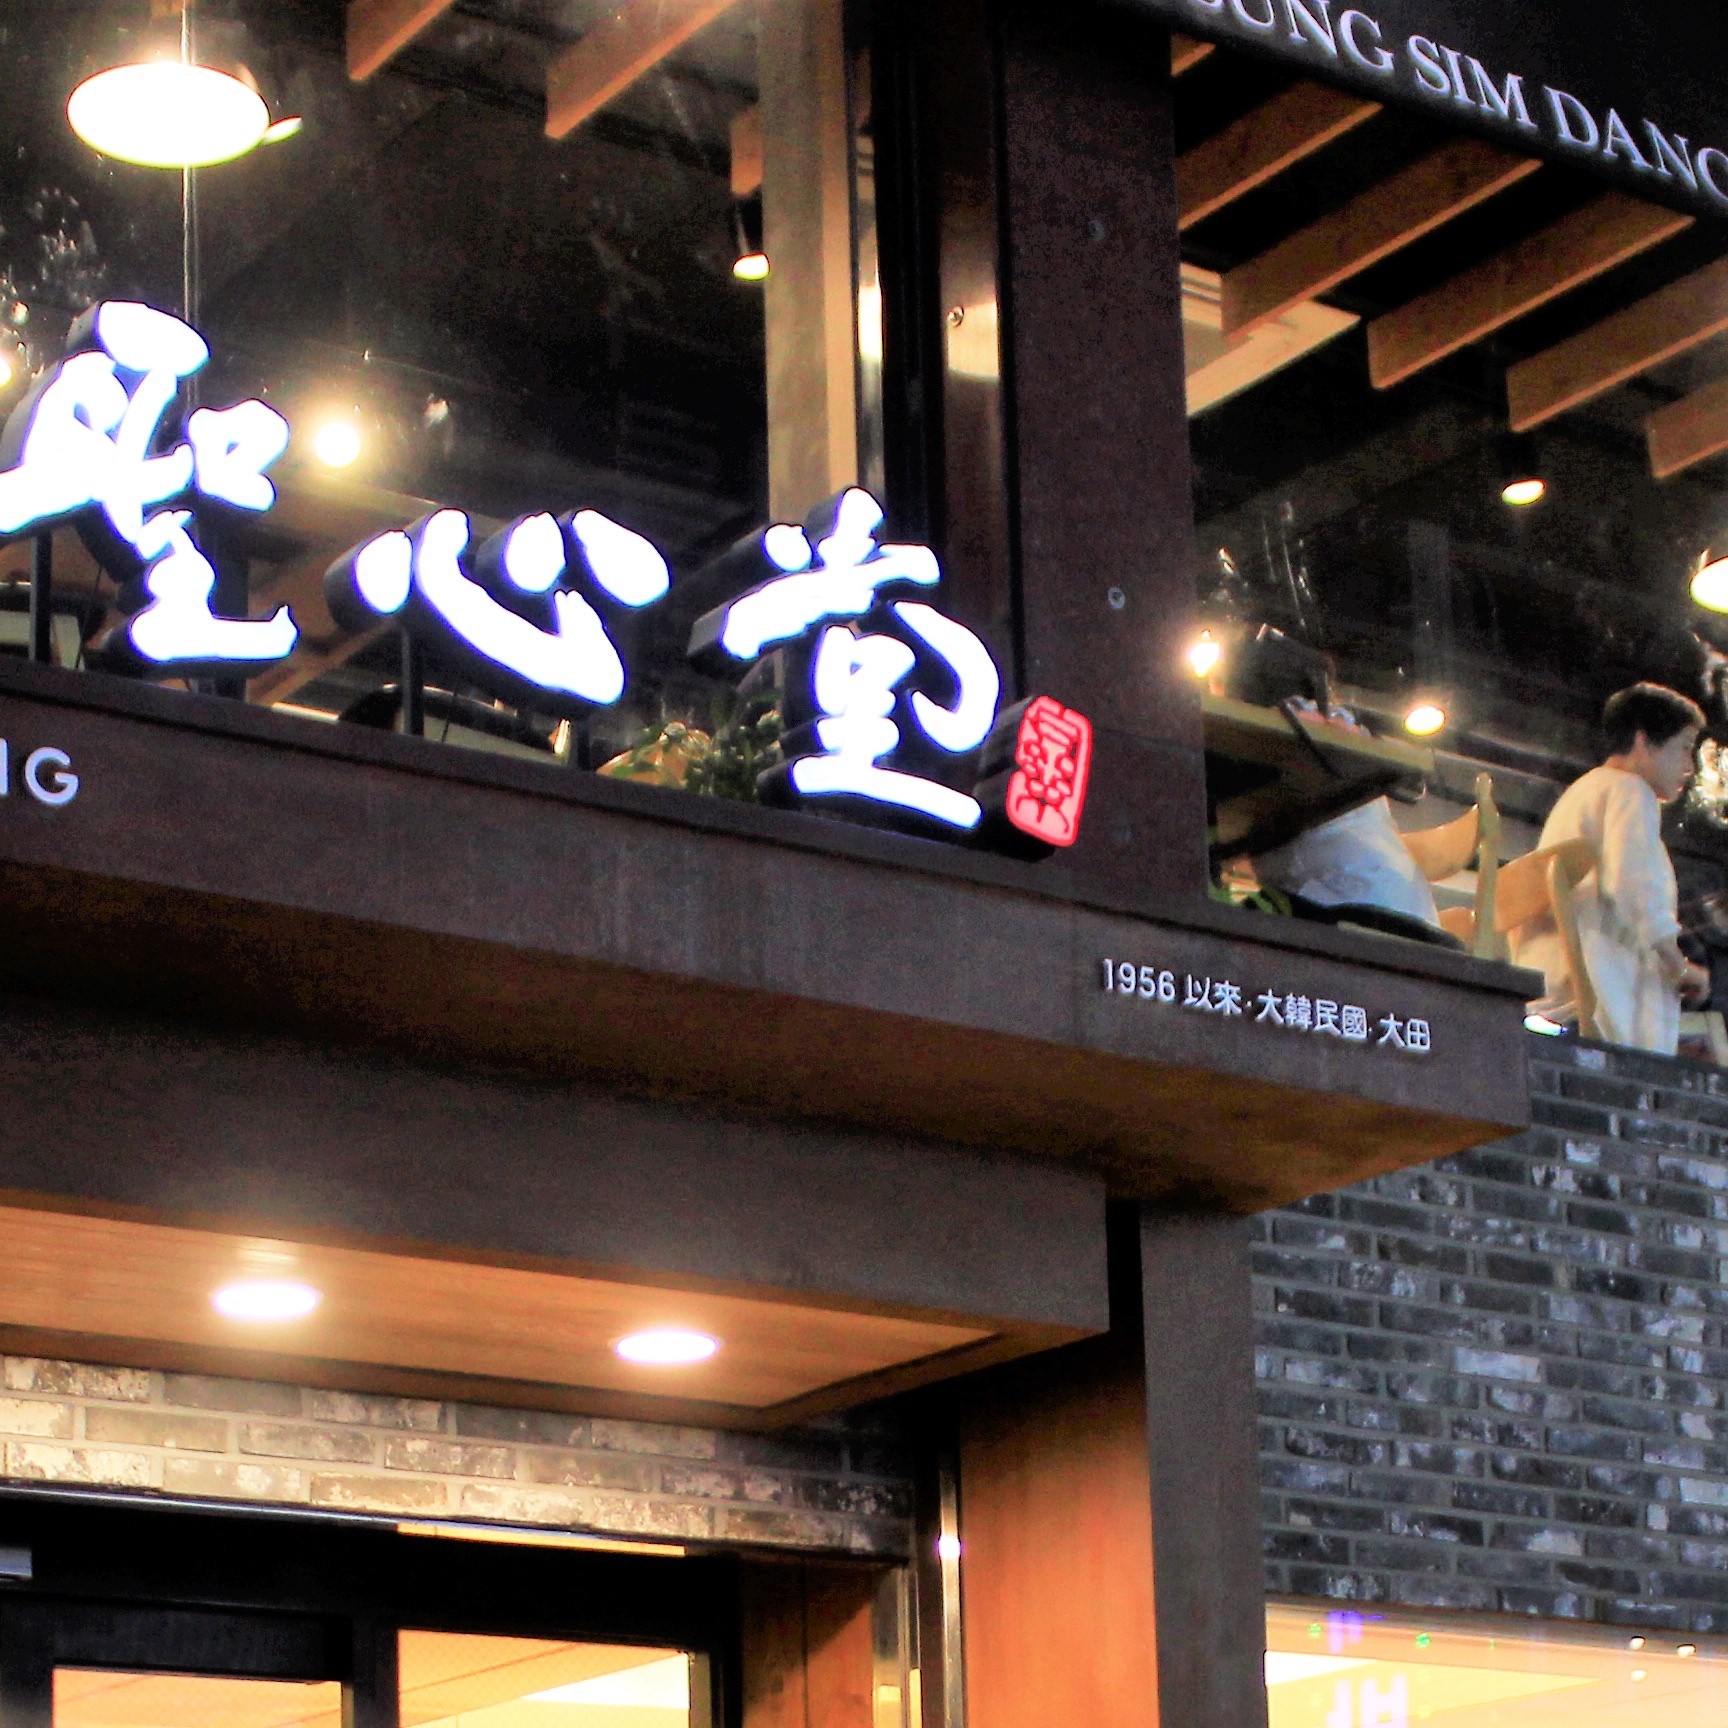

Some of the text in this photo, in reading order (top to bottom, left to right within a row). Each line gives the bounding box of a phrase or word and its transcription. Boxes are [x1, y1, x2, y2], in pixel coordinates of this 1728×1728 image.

[1194, 0, 1395, 75] NG
[1406, 34, 1534, 128] SIM
[1102, 958, 1176, 1001] 1956
